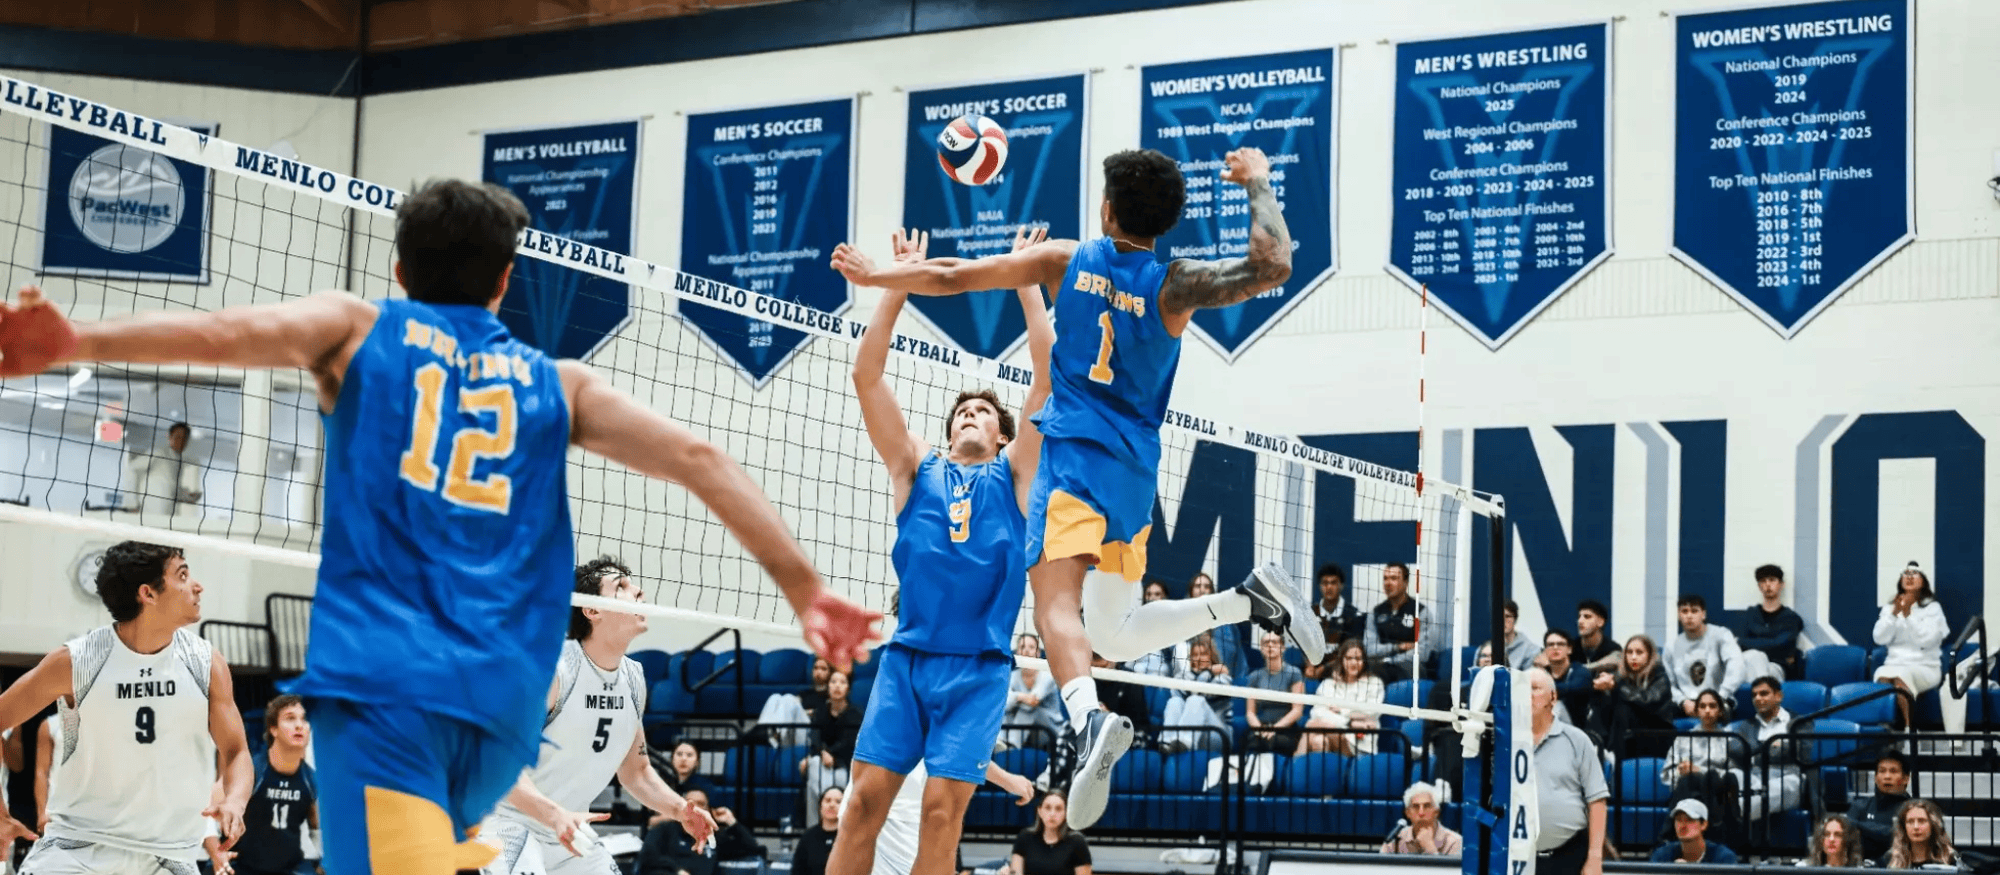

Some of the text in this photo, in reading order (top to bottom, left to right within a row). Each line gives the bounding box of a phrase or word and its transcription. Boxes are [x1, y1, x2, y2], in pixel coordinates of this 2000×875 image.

[1692, 14, 1892, 48] WOMEN'S WRESTLING
[1415, 43, 1587, 74] MEN'S WRESTLING
[1725, 52, 1857, 73] National Champions
[1150, 66, 1326, 97] WOMEN'S VOLLEYBALL
[1440, 79, 1561, 98] National Champions
[1774, 73, 1807, 87] 2019
[924, 92, 1067, 121] WOMEN'S SOCCER
[1485, 99, 1514, 112] 2025
[1774, 91, 1806, 104] 2024
[1219, 102, 1254, 117] NCAA
[1185, 124, 1211, 136] West
[1213, 120, 1251, 136] Region
[1253, 116, 1315, 131] Champions
[1423, 118, 1578, 140] West Regional Champions
[1716, 109, 1866, 131] Conference Champions
[714, 117, 823, 142] MEN'S SOCCER
[1003, 125, 1053, 139] ampions
[1710, 126, 1872, 150] 2020 2022 2024 2025
[493, 137, 627, 162] MEN'S VOLLEYBALL
[1465, 139, 1534, 154] 2004 2006
[713, 149, 822, 166] Conference Champions
[1176, 158, 1228, 172] Conferenc
[234, 146, 405, 211] MENLO COL
[754, 165, 778, 178] 2011
[1430, 161, 1568, 181] Conference Champions
[1709, 166, 1873, 190] Top Ten National Finishes
[753, 179, 778, 192] 2012
[1405, 175, 1595, 200] 2018 2020 2023 2024 2025
[753, 193, 778, 206] 2016
[1756, 188, 1823, 203] 2010 8th
[81, 197, 171, 218] PacWest
[976, 210, 1004, 221] NAIA
[1184, 204, 1249, 219] 2013 2014
[1423, 201, 1575, 224] Top Ten National Finishes
[1756, 202, 1823, 217] 2016 7th
[931, 227, 974, 239] National
[1566, 221, 1585, 230] 2nd
[1756, 216, 1823, 232] 2018 5th
[1219, 228, 1249, 240] NAIA
[1758, 231, 1821, 245] 2019 1st
[516, 230, 625, 275] LEYBALL
[708, 247, 821, 265] National Championship
[1170, 244, 1217, 257] National
[1756, 243, 1822, 260] 2022 3rd
[1567, 256, 1584, 266] 3rd
[1756, 258, 1822, 274] 2023 4th
[1757, 273, 1820, 288] 2024 1st
[675, 272, 747, 309] MENLO
[755, 295, 843, 335] COLLEGE
[1088, 310, 1115, 385] 1
[398, 361, 518, 516] 12
[1244, 430, 1416, 489] MENLO COLLEGE VOLLEYBALL
[949, 498, 972, 543] 9
[116, 680, 176, 699] MENLO
[585, 694, 624, 710] MENLO
[135, 706, 156, 744] 9
[592, 717, 613, 753] 5
[267, 788, 301, 801] MENLO
[271, 803, 289, 829] 11
